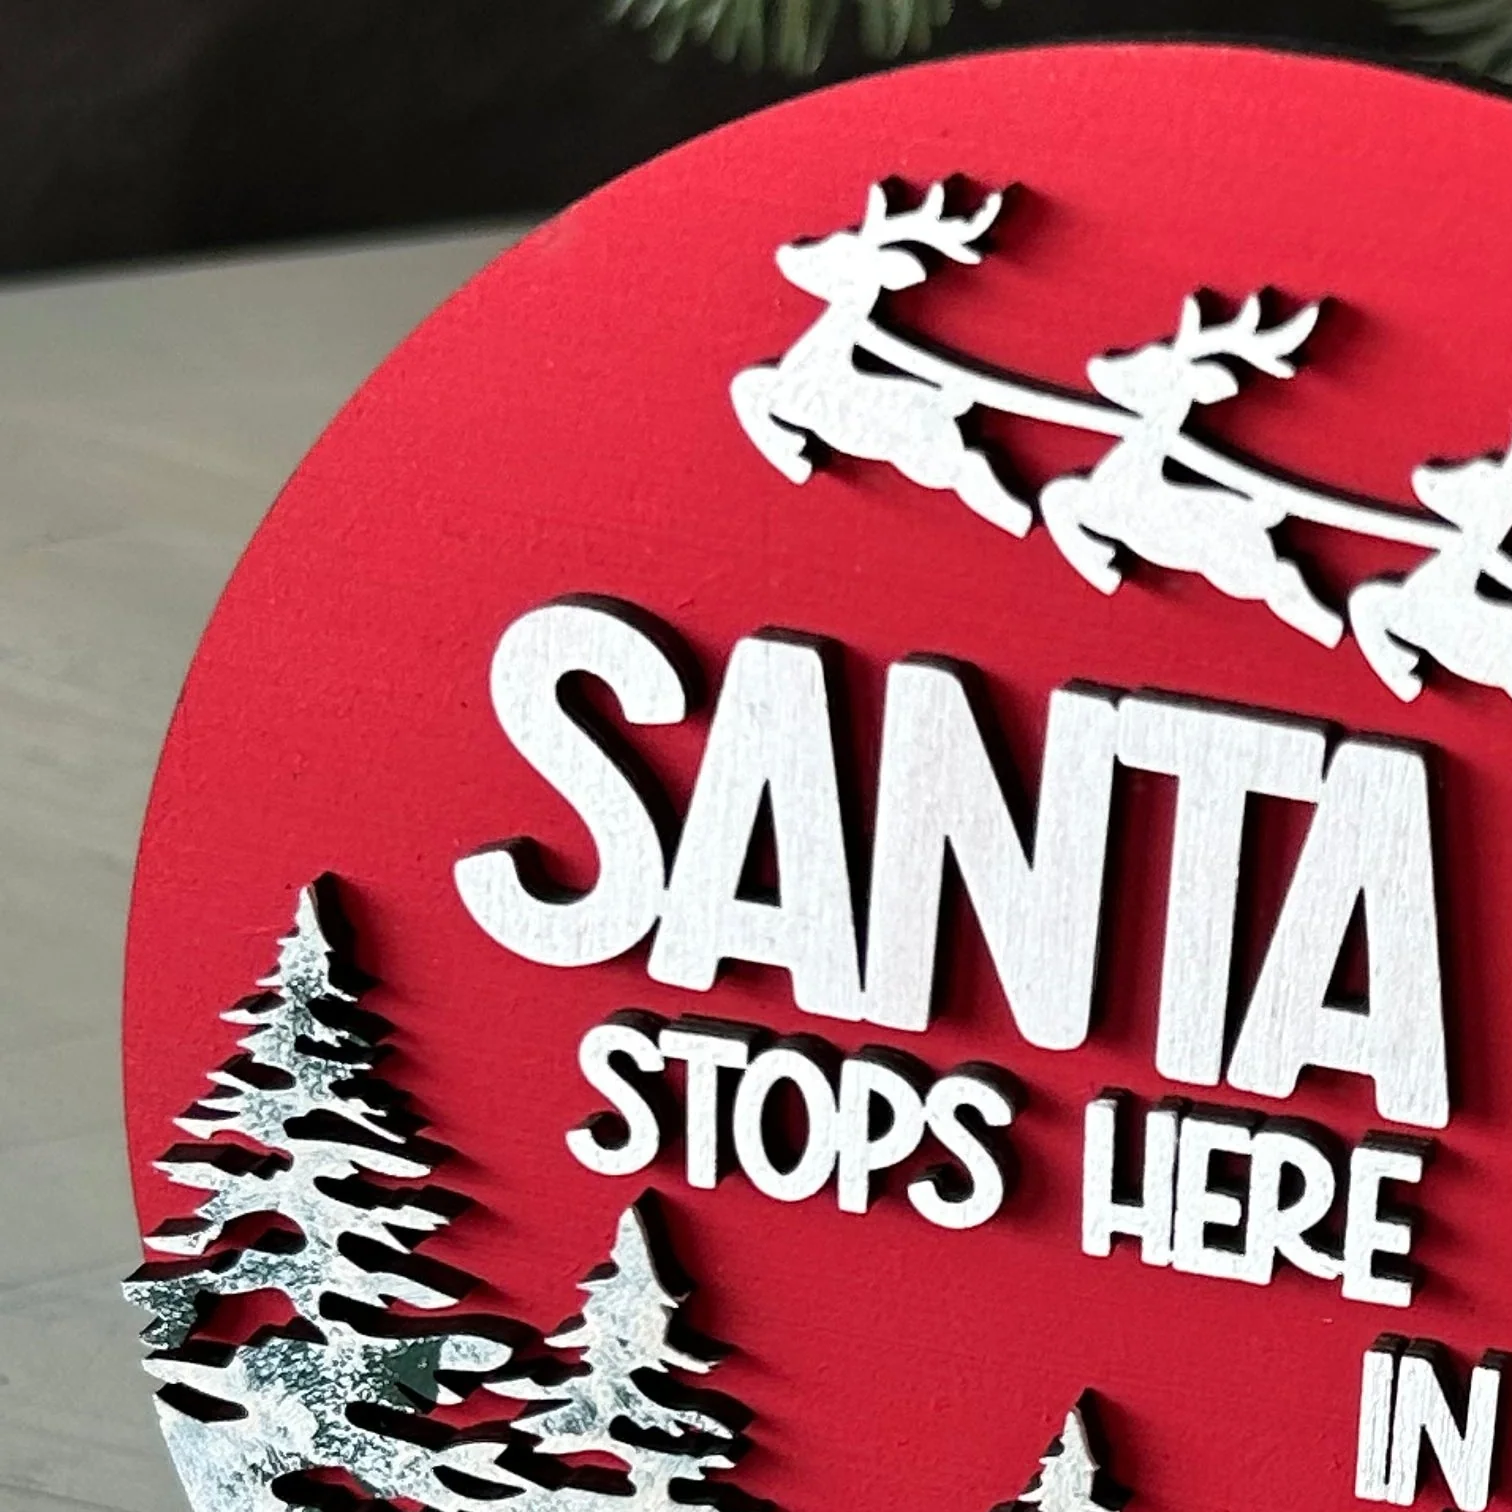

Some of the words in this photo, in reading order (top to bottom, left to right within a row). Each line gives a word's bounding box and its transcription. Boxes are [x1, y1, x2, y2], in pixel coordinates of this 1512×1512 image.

[454, 603, 1450, 1129] SANTA
[565, 1022, 1012, 1229] STOPS
[1081, 1097, 1423, 1307] HERE
[1353, 1349, 1501, 1512] IN
